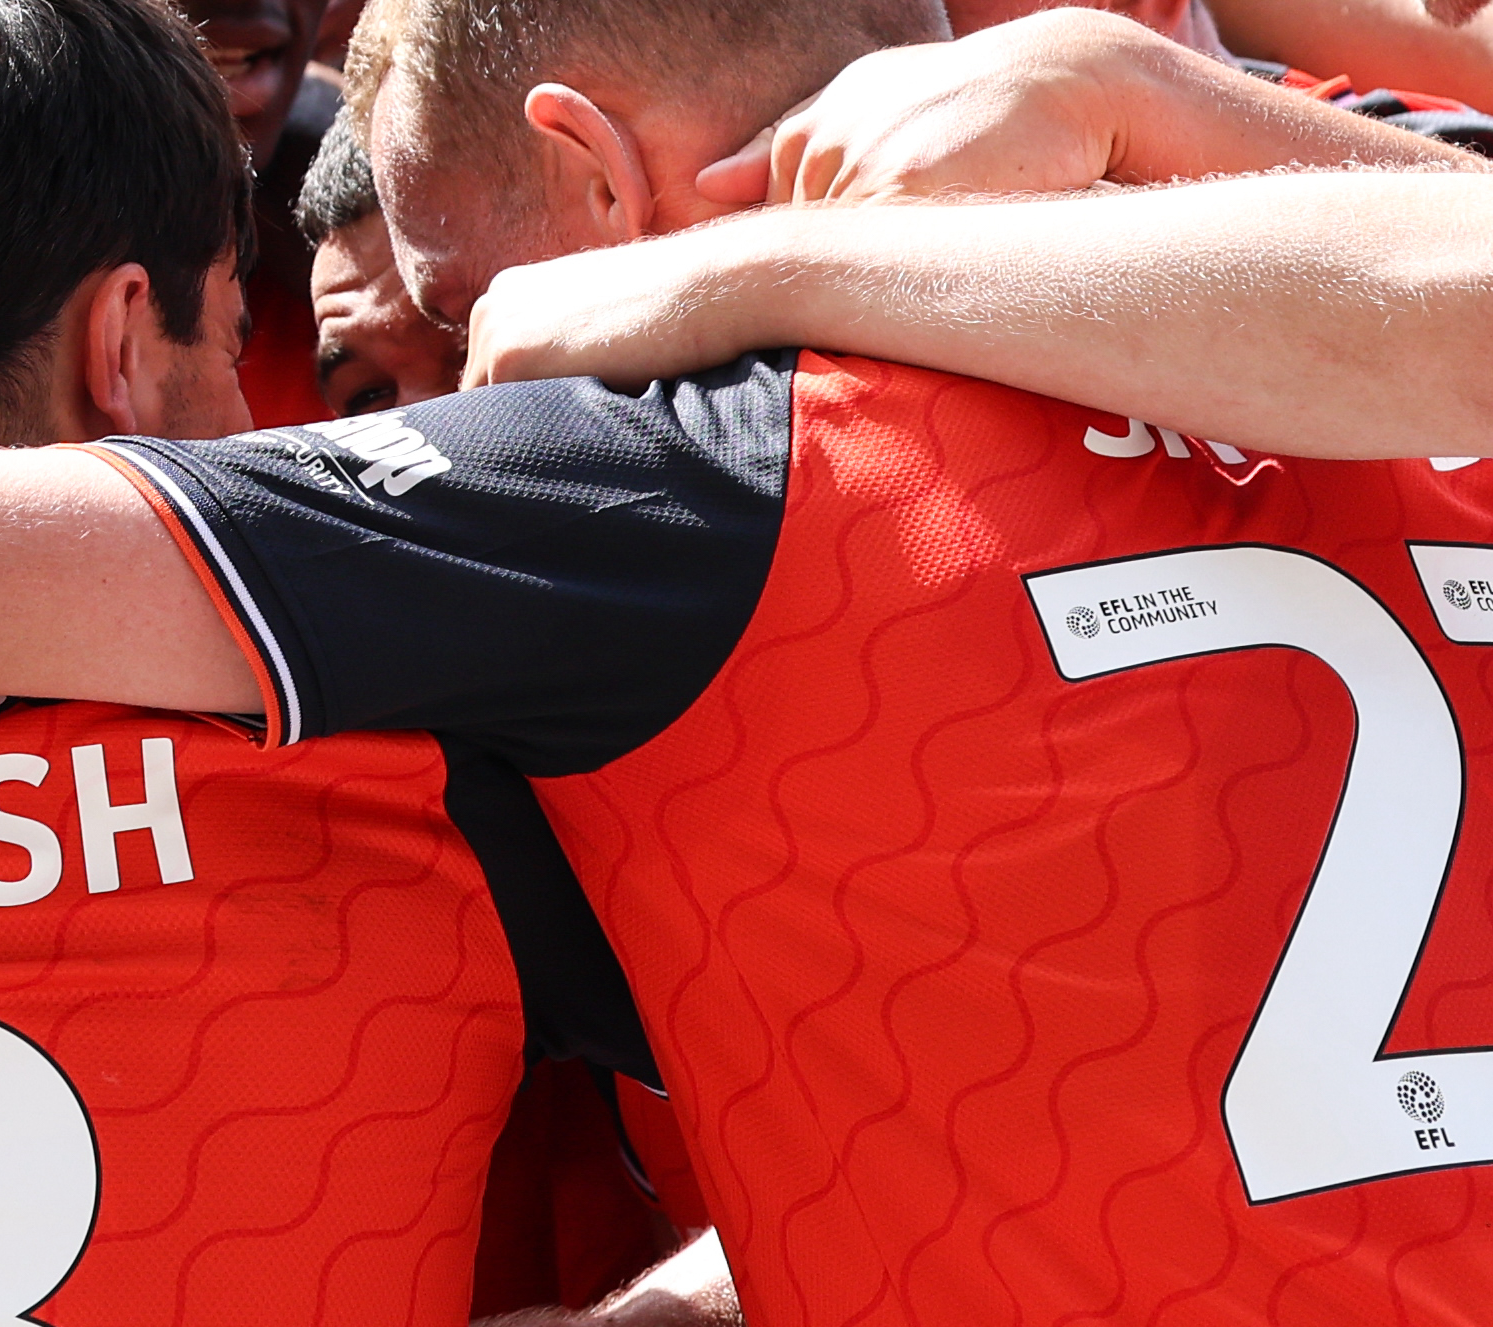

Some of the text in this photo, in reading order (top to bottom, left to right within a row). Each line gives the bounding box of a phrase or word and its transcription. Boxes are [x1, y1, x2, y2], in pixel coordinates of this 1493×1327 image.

[1098, 586, 1195, 617] EFL IN THE
[1107, 600, 1218, 634] COMMUNITY
[1414, 1127, 1456, 1150] EFL
